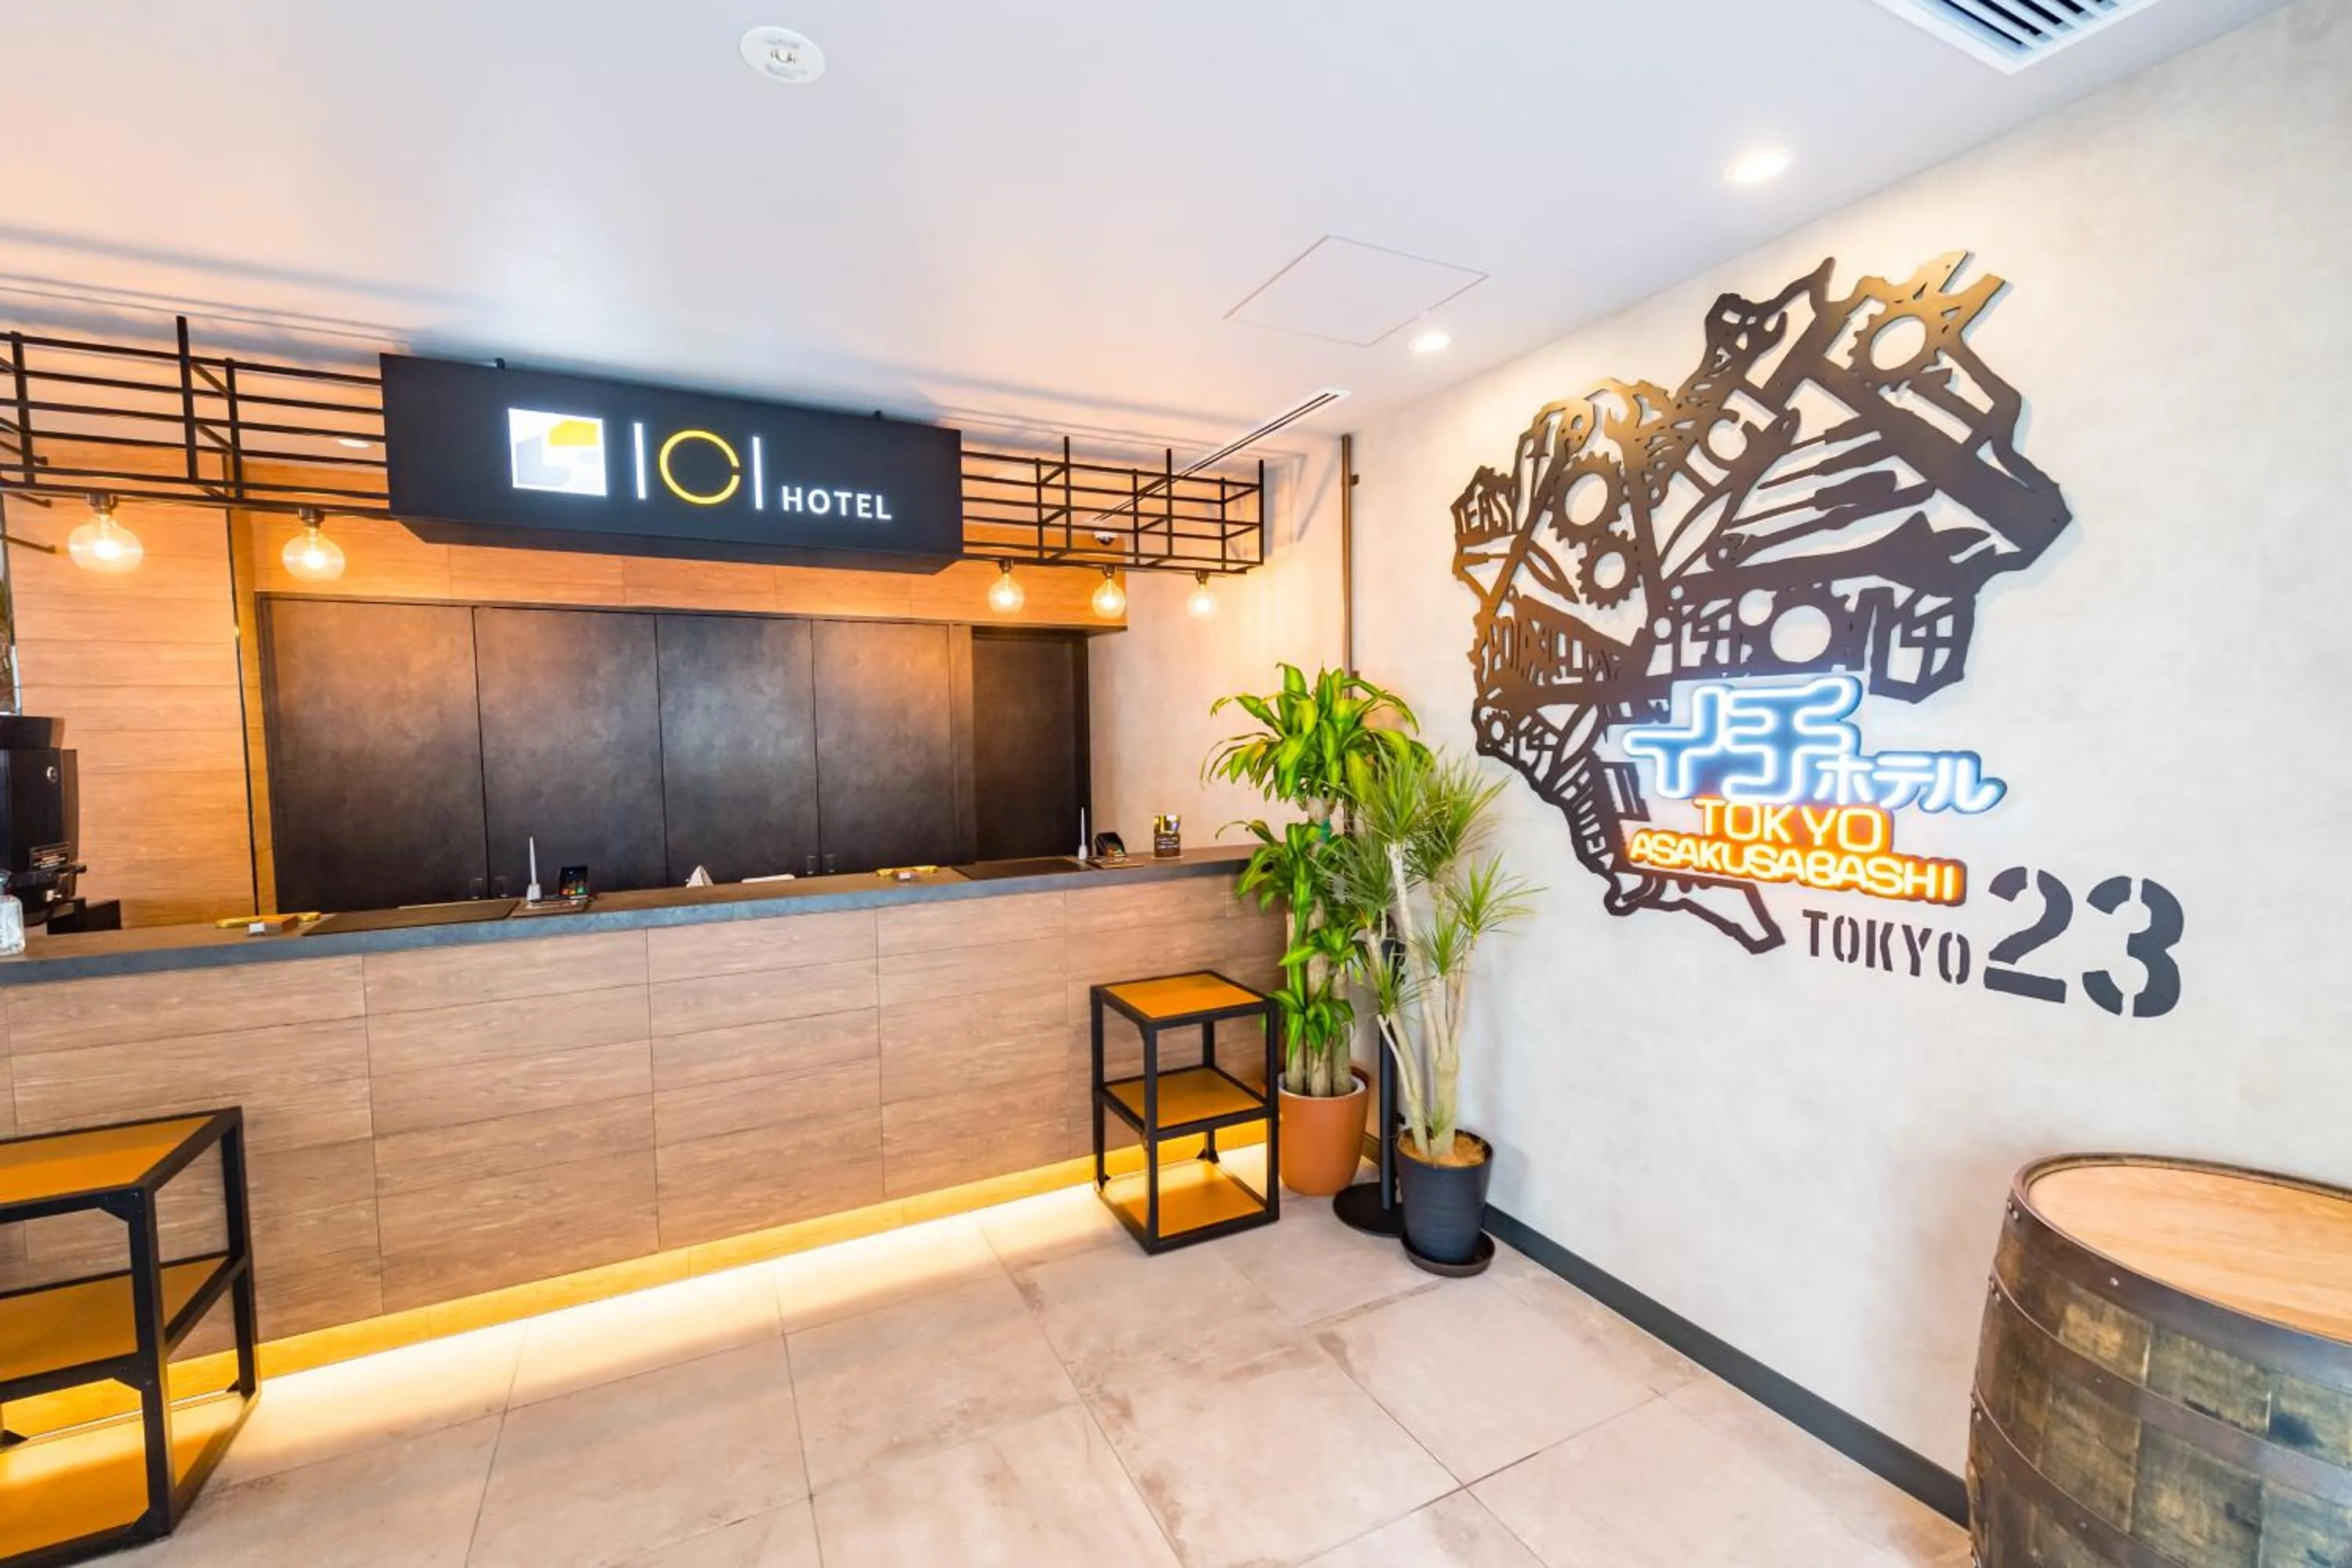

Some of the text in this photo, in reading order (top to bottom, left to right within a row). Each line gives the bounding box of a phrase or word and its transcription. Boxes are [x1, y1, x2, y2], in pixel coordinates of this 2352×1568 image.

[782, 485, 892, 520] HOTEL
[1694, 797, 1883, 854] TOKYO
[1630, 832, 1955, 901] ASAKUSABASHI
[1802, 866, 2184, 1018] TOKYO 23
